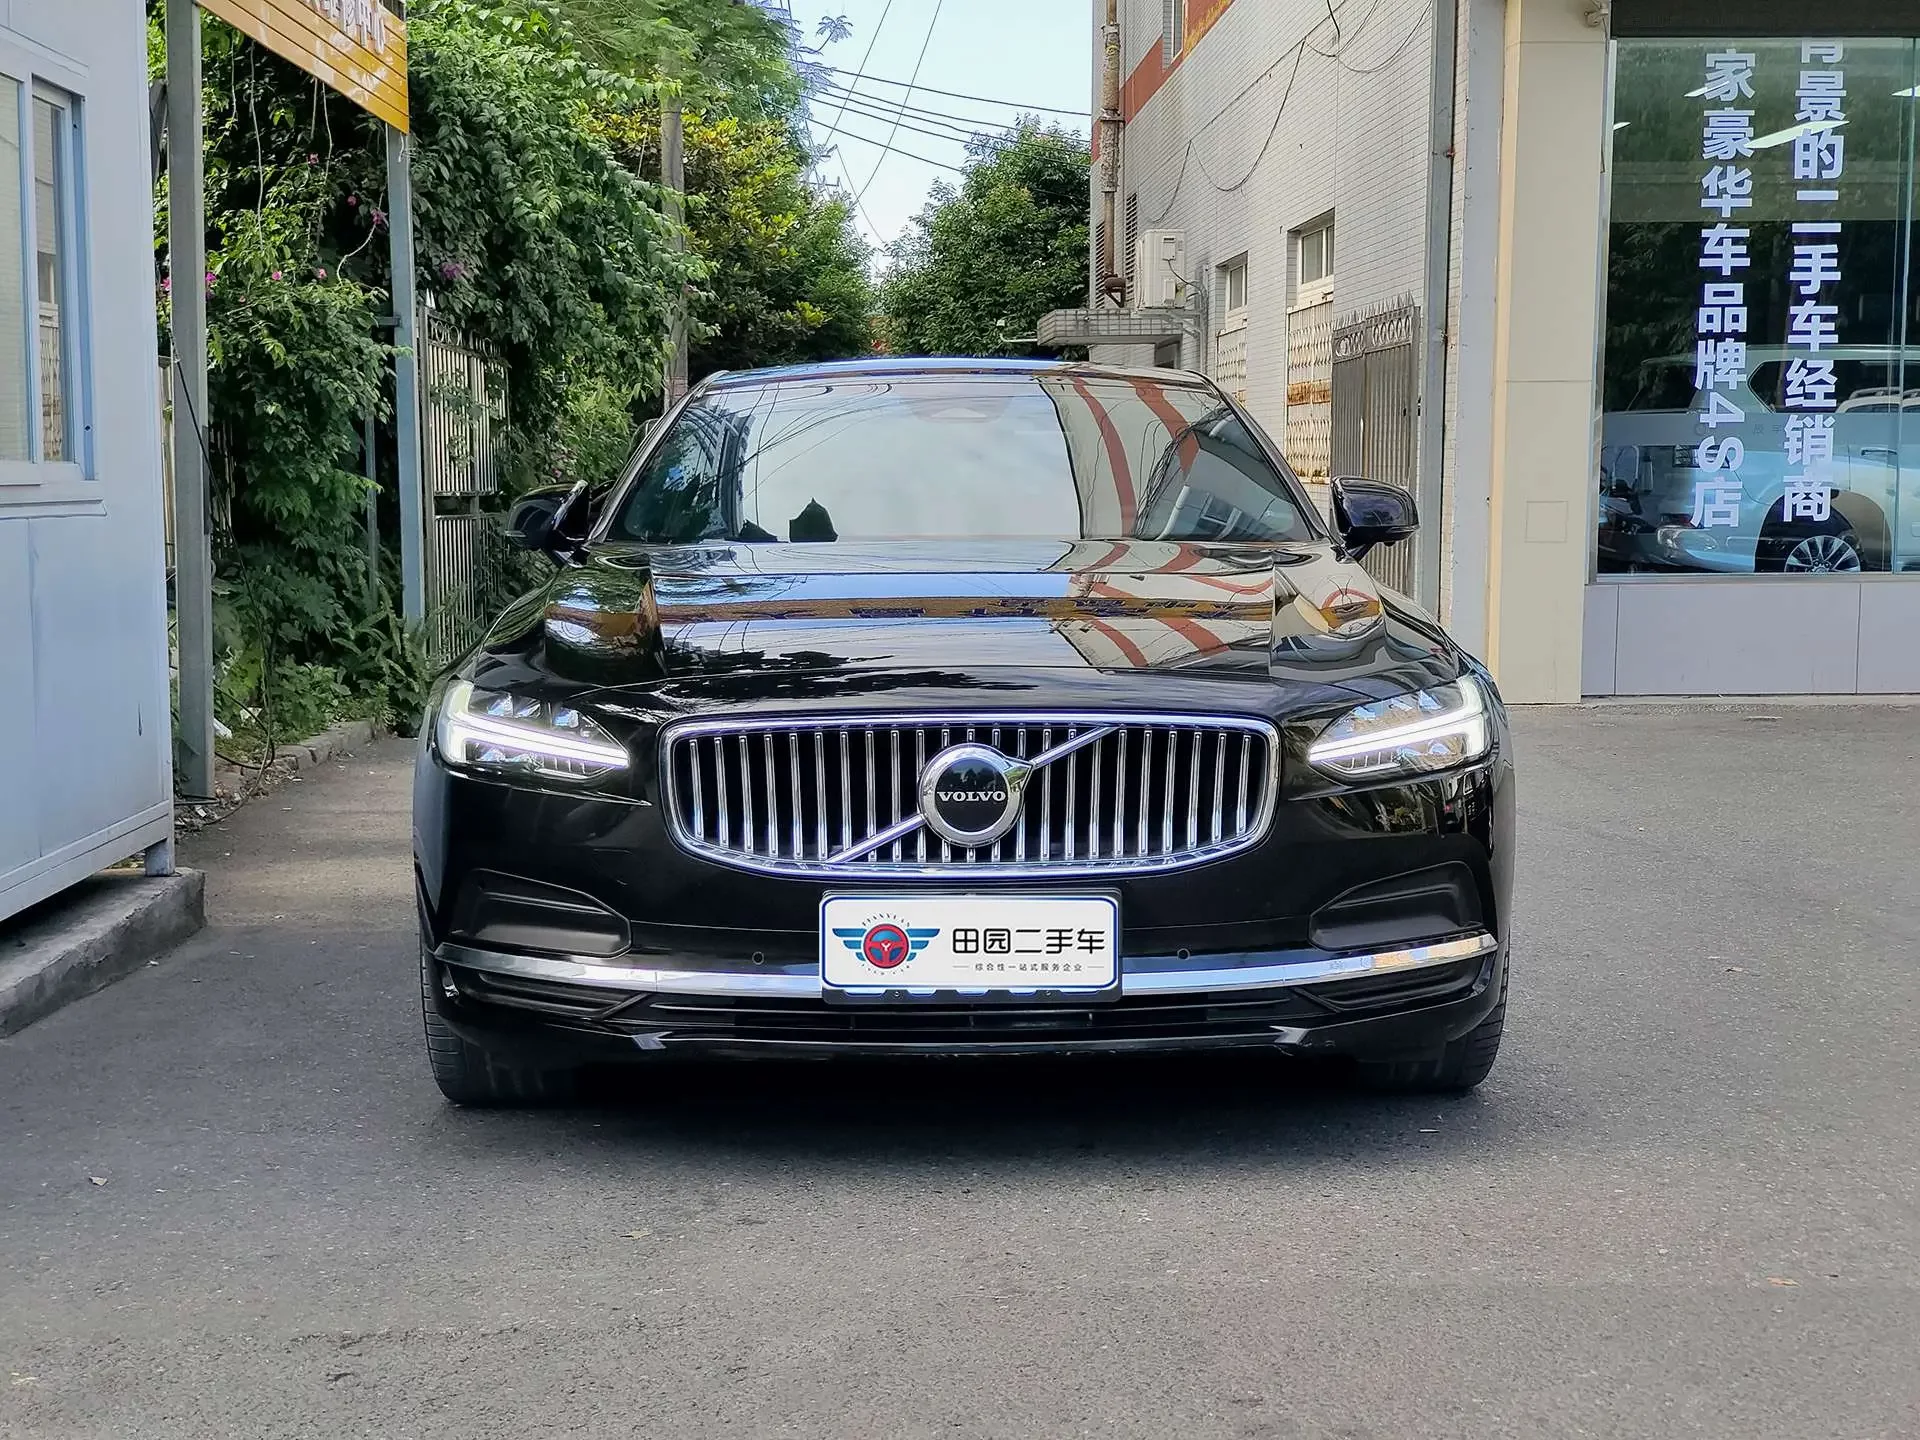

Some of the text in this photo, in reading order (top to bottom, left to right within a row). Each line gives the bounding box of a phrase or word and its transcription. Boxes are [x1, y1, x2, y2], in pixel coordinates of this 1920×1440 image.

[1689, 48, 1756, 528] 家豪华车品牌4S店
[937, 790, 1007, 802] VOLVO
[952, 928, 1105, 955] 田园二手车
[974, 962, 1083, 972] 综合性一站式服务企业
